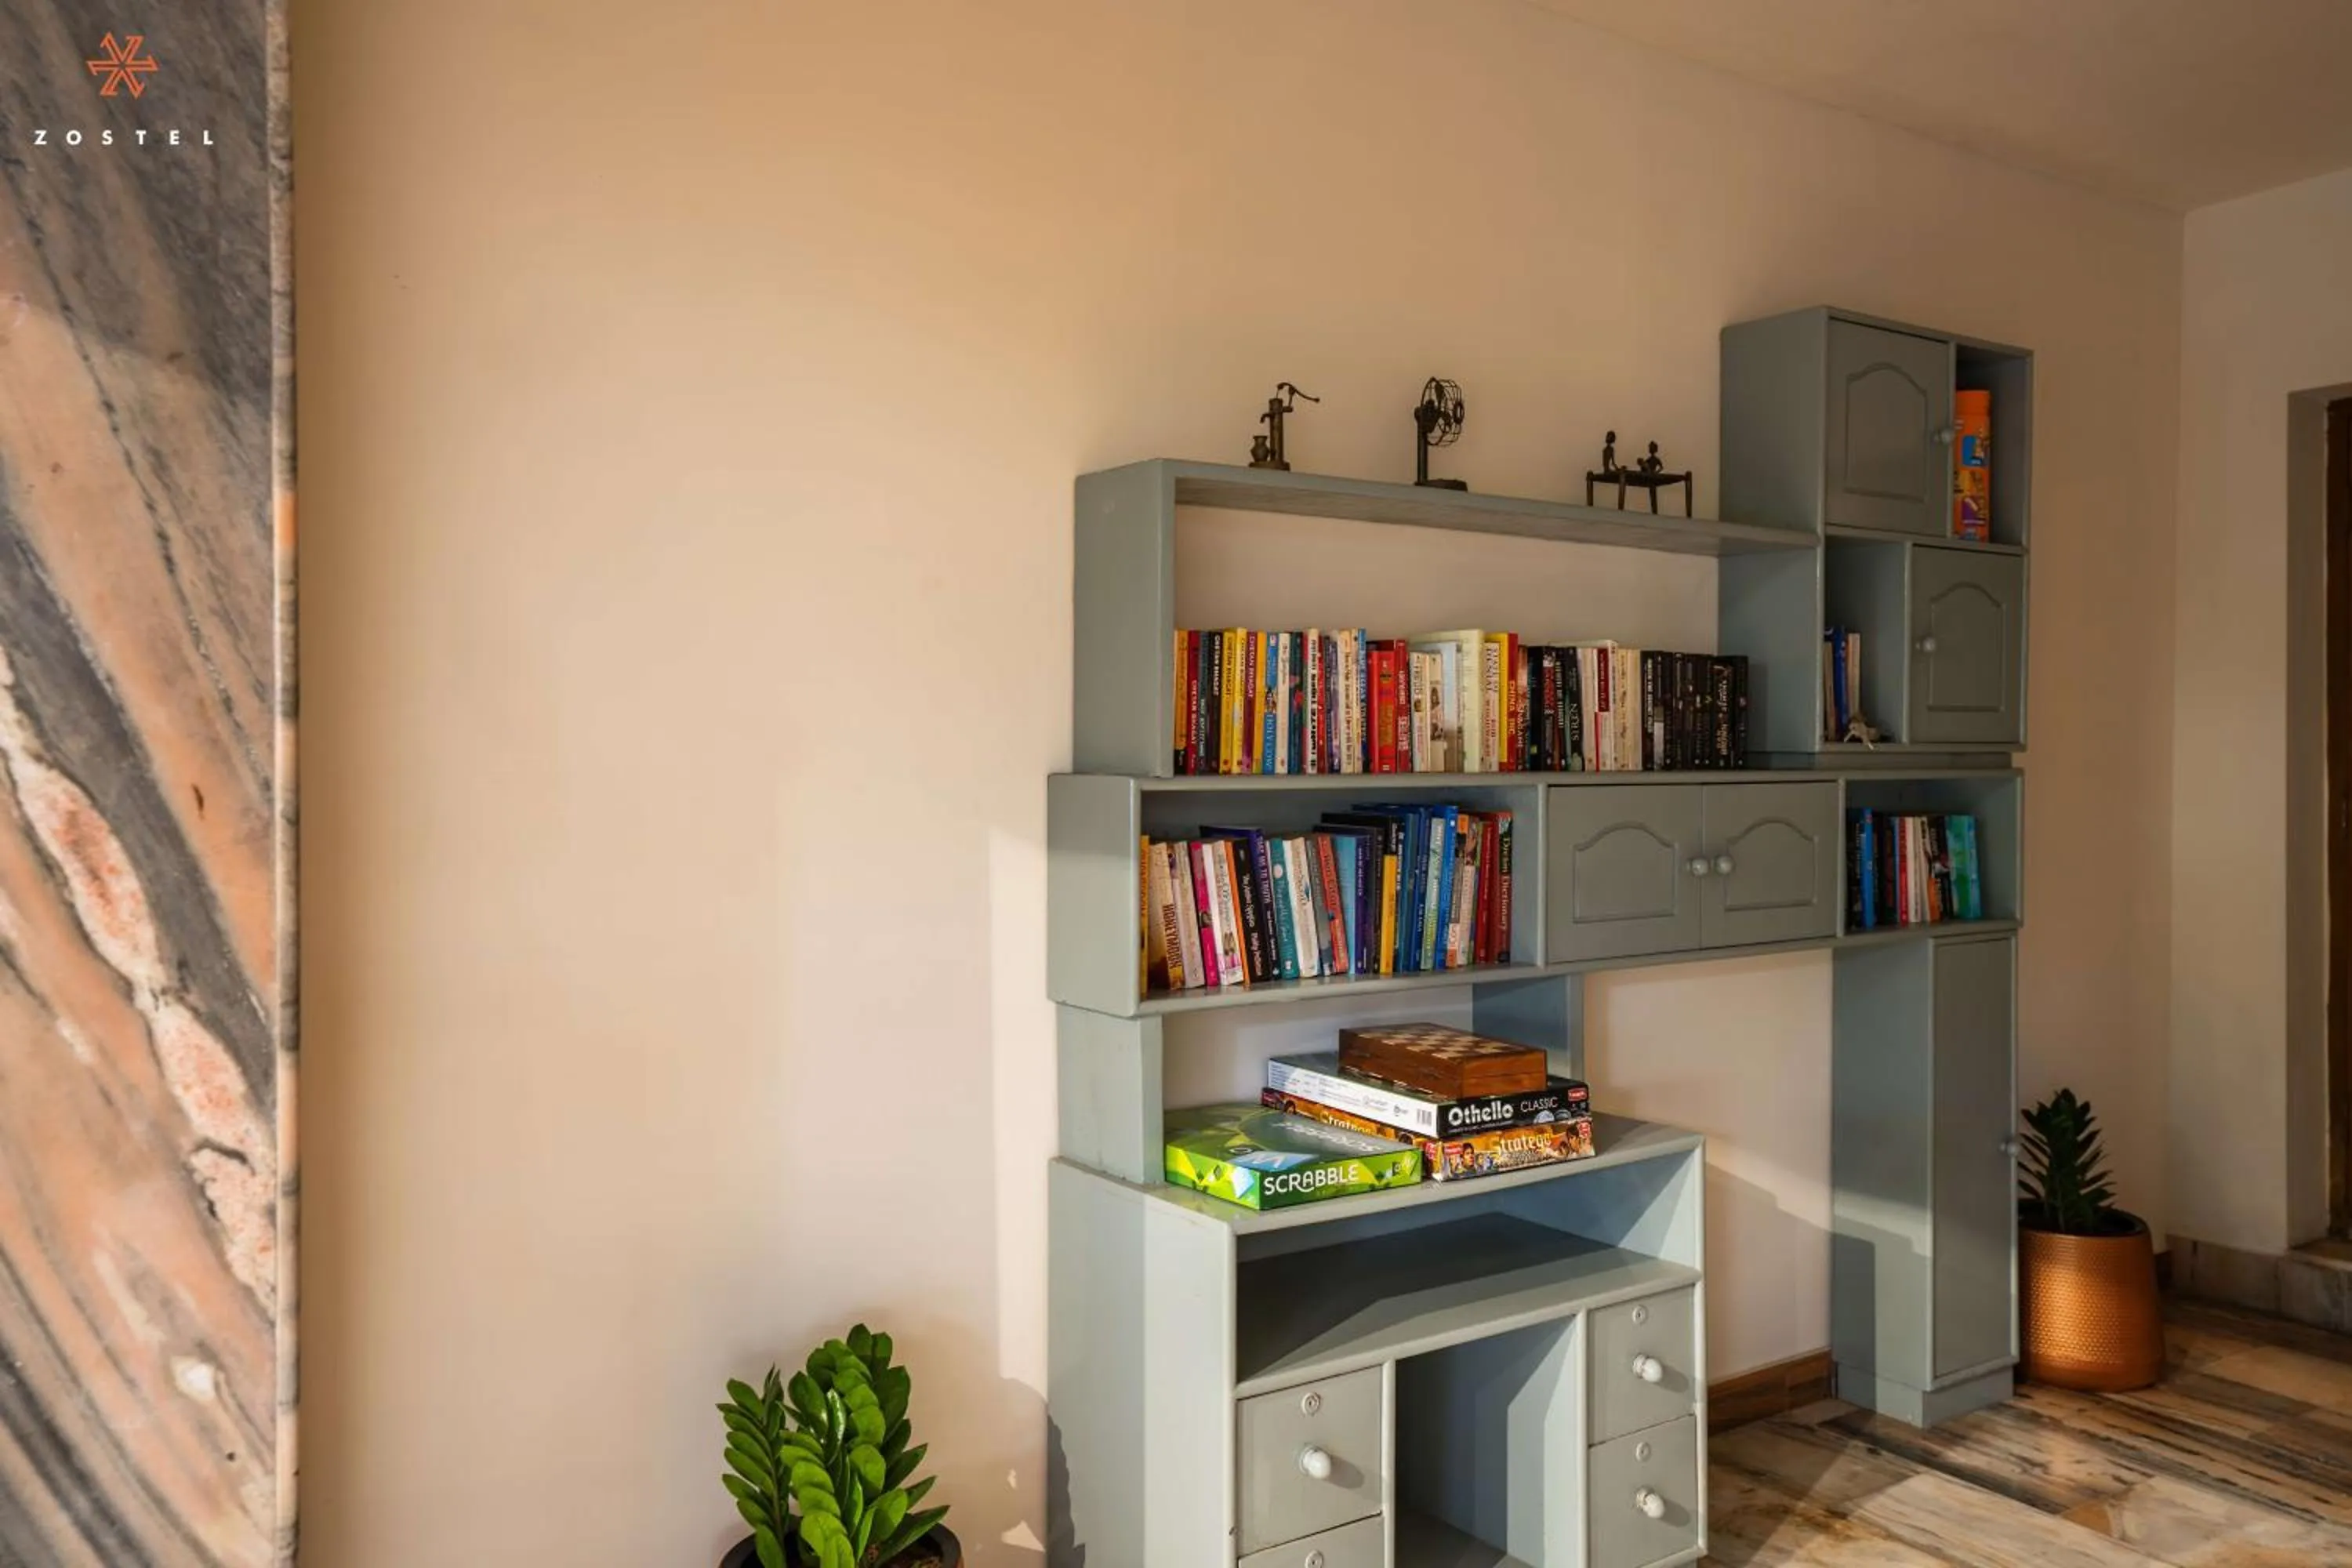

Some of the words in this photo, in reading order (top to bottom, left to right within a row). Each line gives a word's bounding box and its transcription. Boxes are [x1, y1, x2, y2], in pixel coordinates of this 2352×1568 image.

[1500, 875, 1510, 931] Dictionary
[1164, 904, 1181, 969] HONEYMOON
[1448, 1101, 1513, 1126] Othello
[1520, 1097, 1559, 1112] CLASSIC
[1490, 1133, 1552, 1159] Stratego
[1264, 1164, 1359, 1196] SCRABBLE
